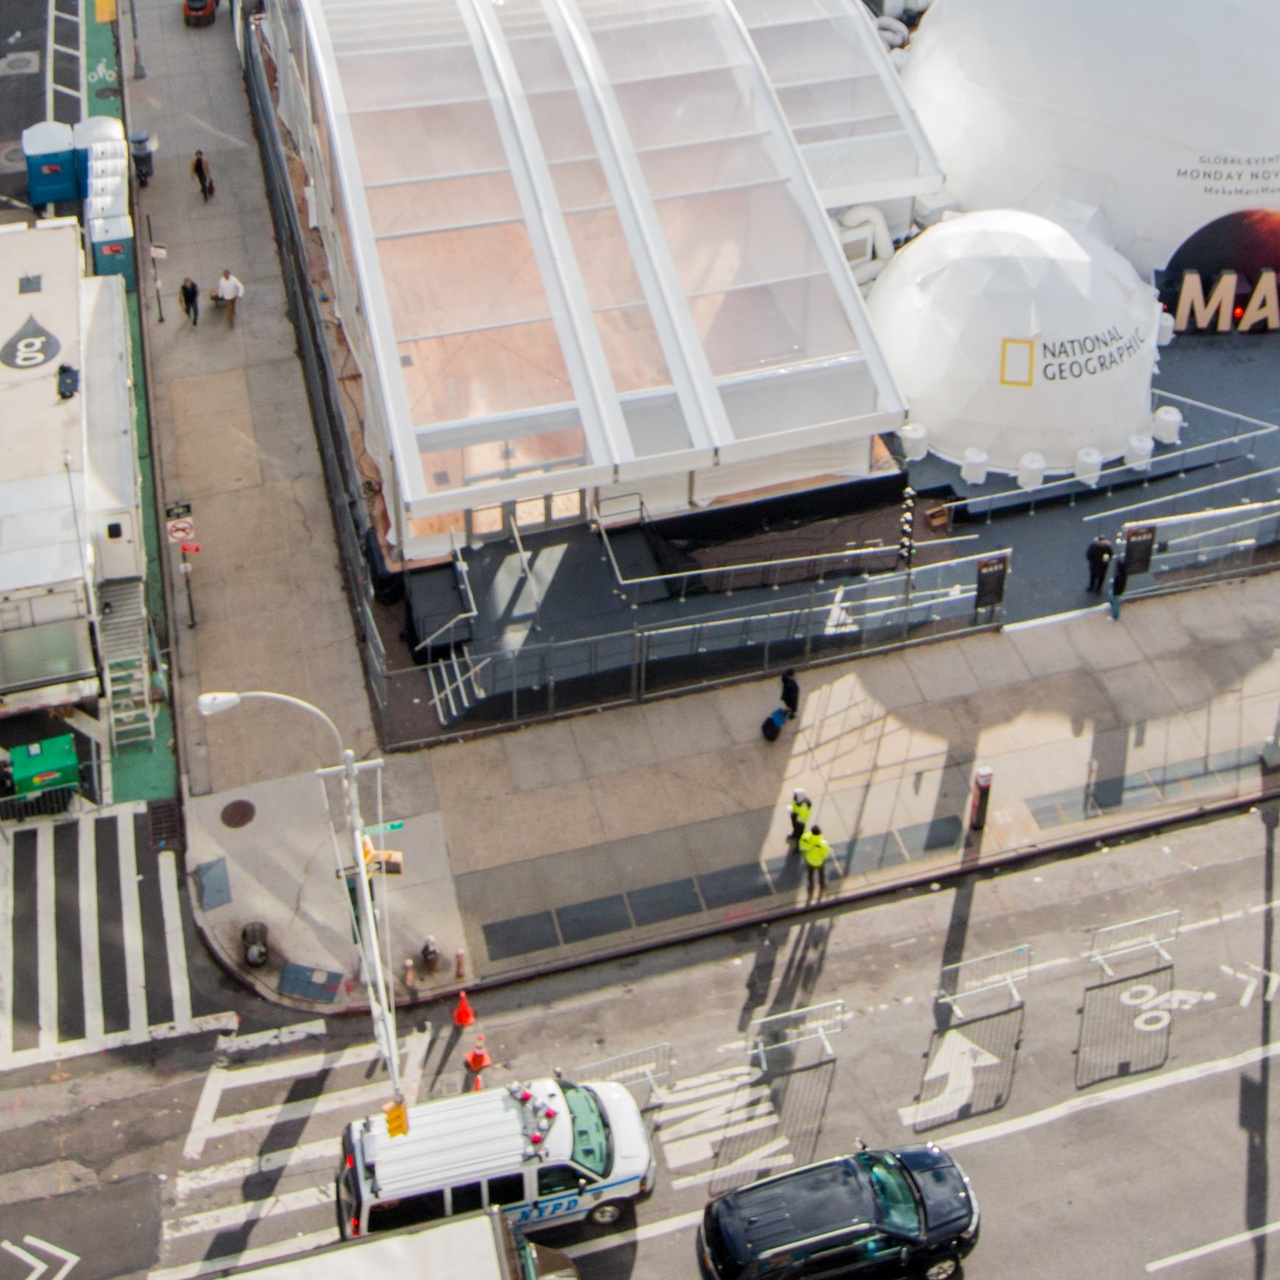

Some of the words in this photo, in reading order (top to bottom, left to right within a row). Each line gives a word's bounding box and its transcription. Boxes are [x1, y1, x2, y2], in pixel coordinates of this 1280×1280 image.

[1176, 167, 1244, 182] MONDAY
[1250, 169, 1280, 181] NOV
[1198, 155, 1242, 165] GLOBAL
[1247, 154, 1280, 166] EVENT
[15, 336, 46, 366] g
[1042, 325, 1124, 359] NATIONAL
[1042, 326, 1146, 381] GEOGRAPHIC
[648, 1066, 797, 1190] ONLY
[519, 1198, 579, 1222] NYPD
